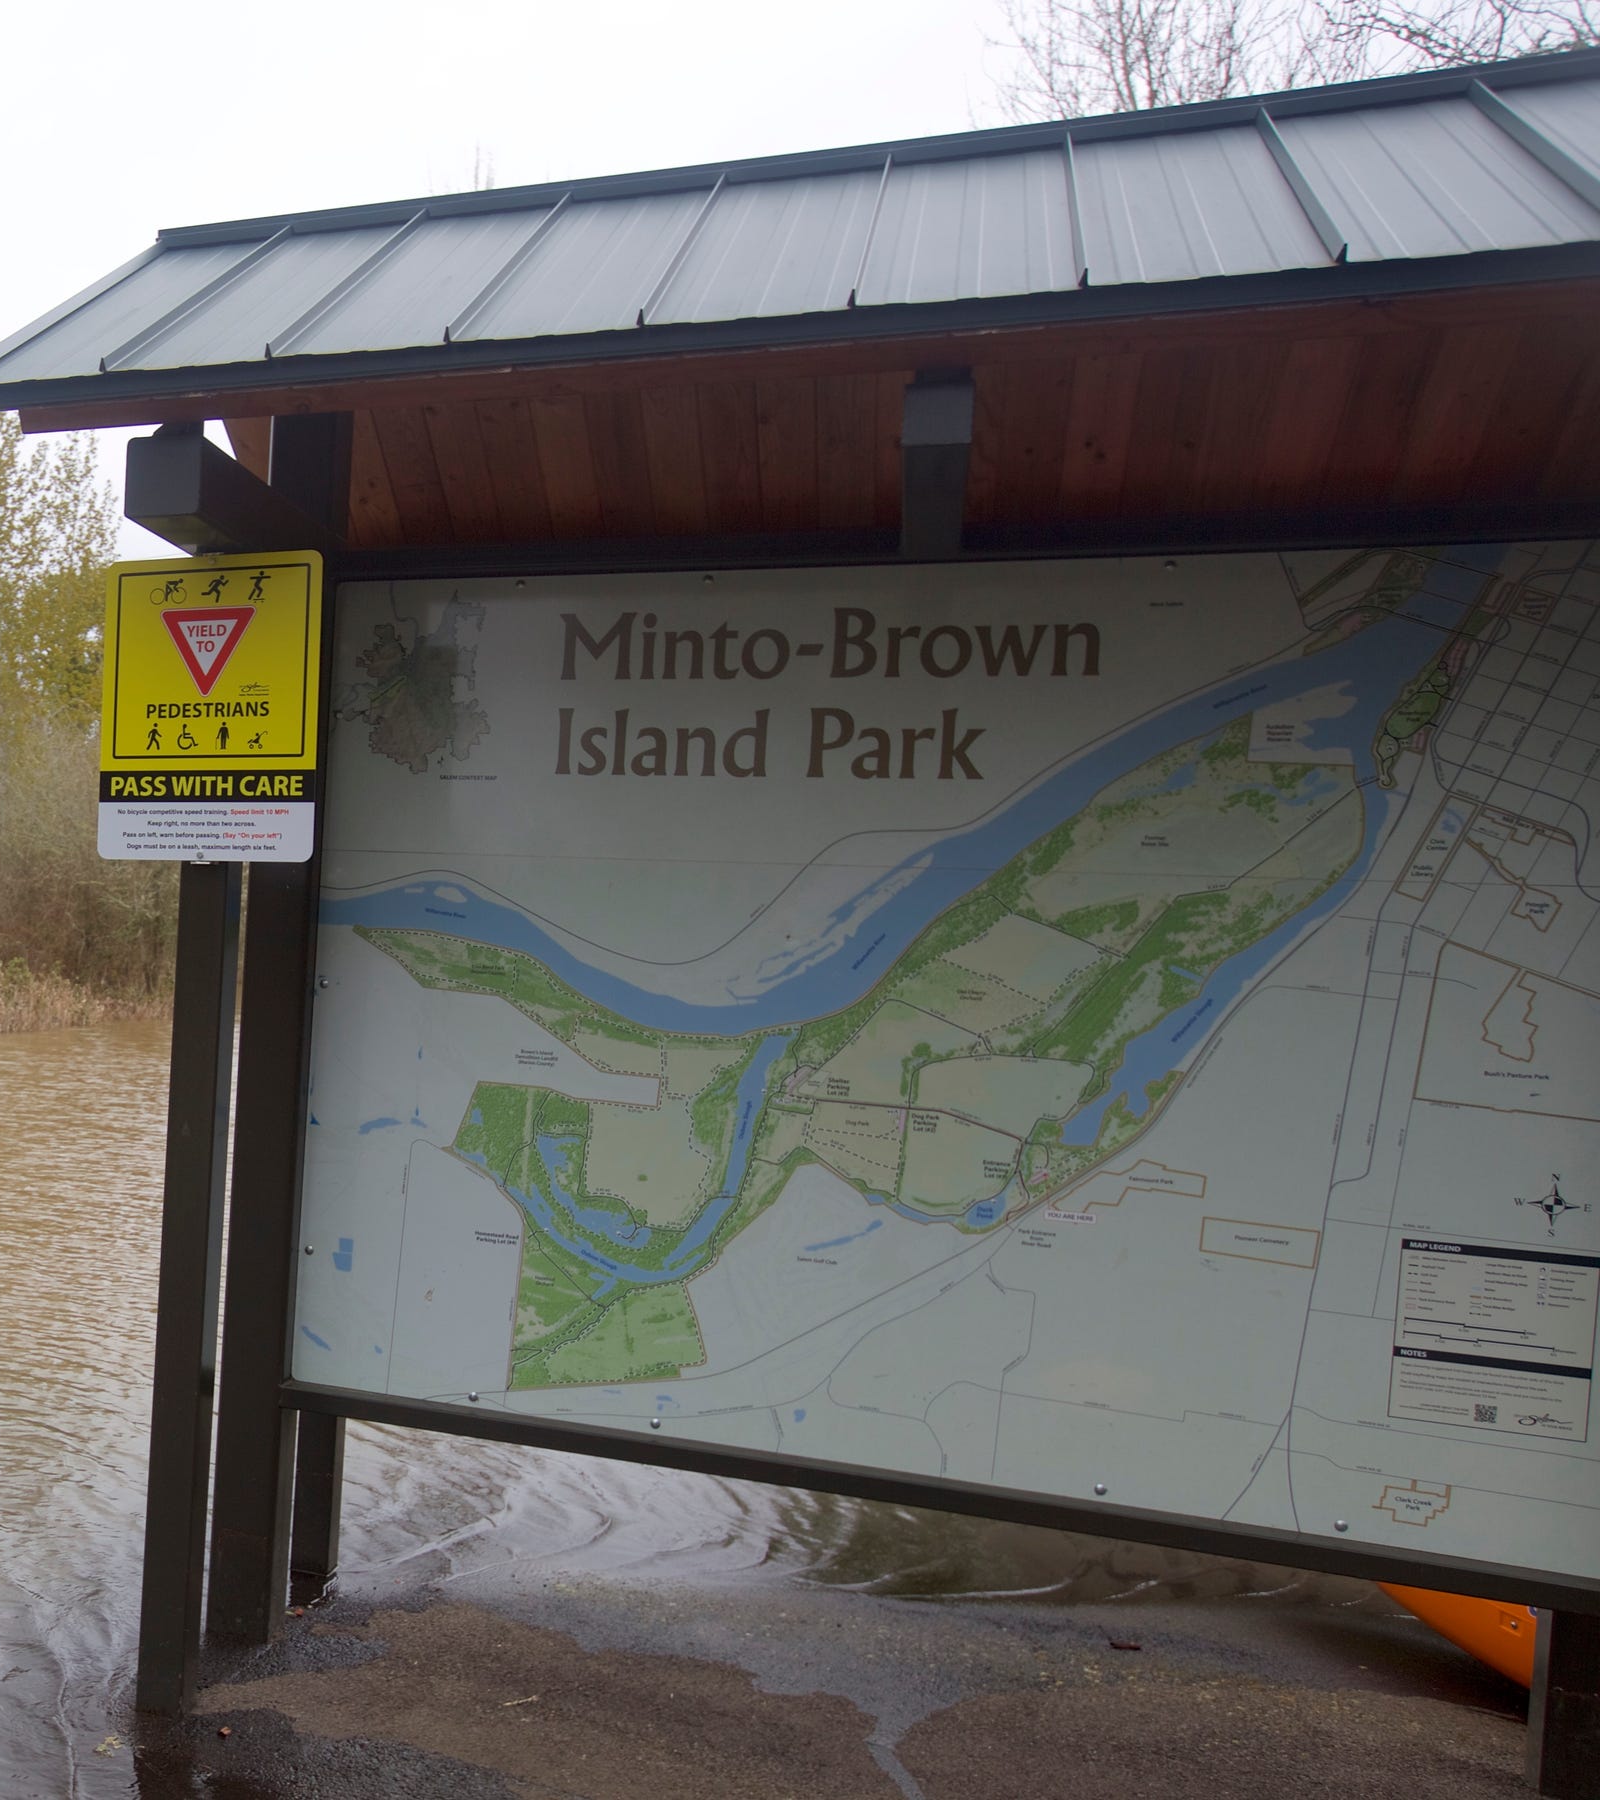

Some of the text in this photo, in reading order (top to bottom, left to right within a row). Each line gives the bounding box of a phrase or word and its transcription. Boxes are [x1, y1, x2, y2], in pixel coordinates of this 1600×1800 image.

[186, 624, 227, 638] YIELD
[196, 640, 216, 653] TO
[559, 607, 1101, 681] Minto-Brown
[146, 701, 270, 719] PEDESTRIANS
[554, 706, 988, 781] Island Park
[110, 775, 304, 797] PASS WITH CARE
[127, 808, 148, 816] bicycle
[149, 808, 183, 816] competitive
[184, 808, 203, 816] speed
[230, 808, 250, 816] Speed
[1551, 1172, 1561, 1182] N
[1513, 1197, 1526, 1207] W
[1583, 1203, 1592, 1212] E
[1048, 1211, 1061, 1219] YOU
[1076, 1214, 1094, 1222] HERE
[1547, 1228, 1556, 1238] S
[1409, 1241, 1462, 1253] MAP LEGEND
[1400, 1348, 1428, 1358] NOTES
